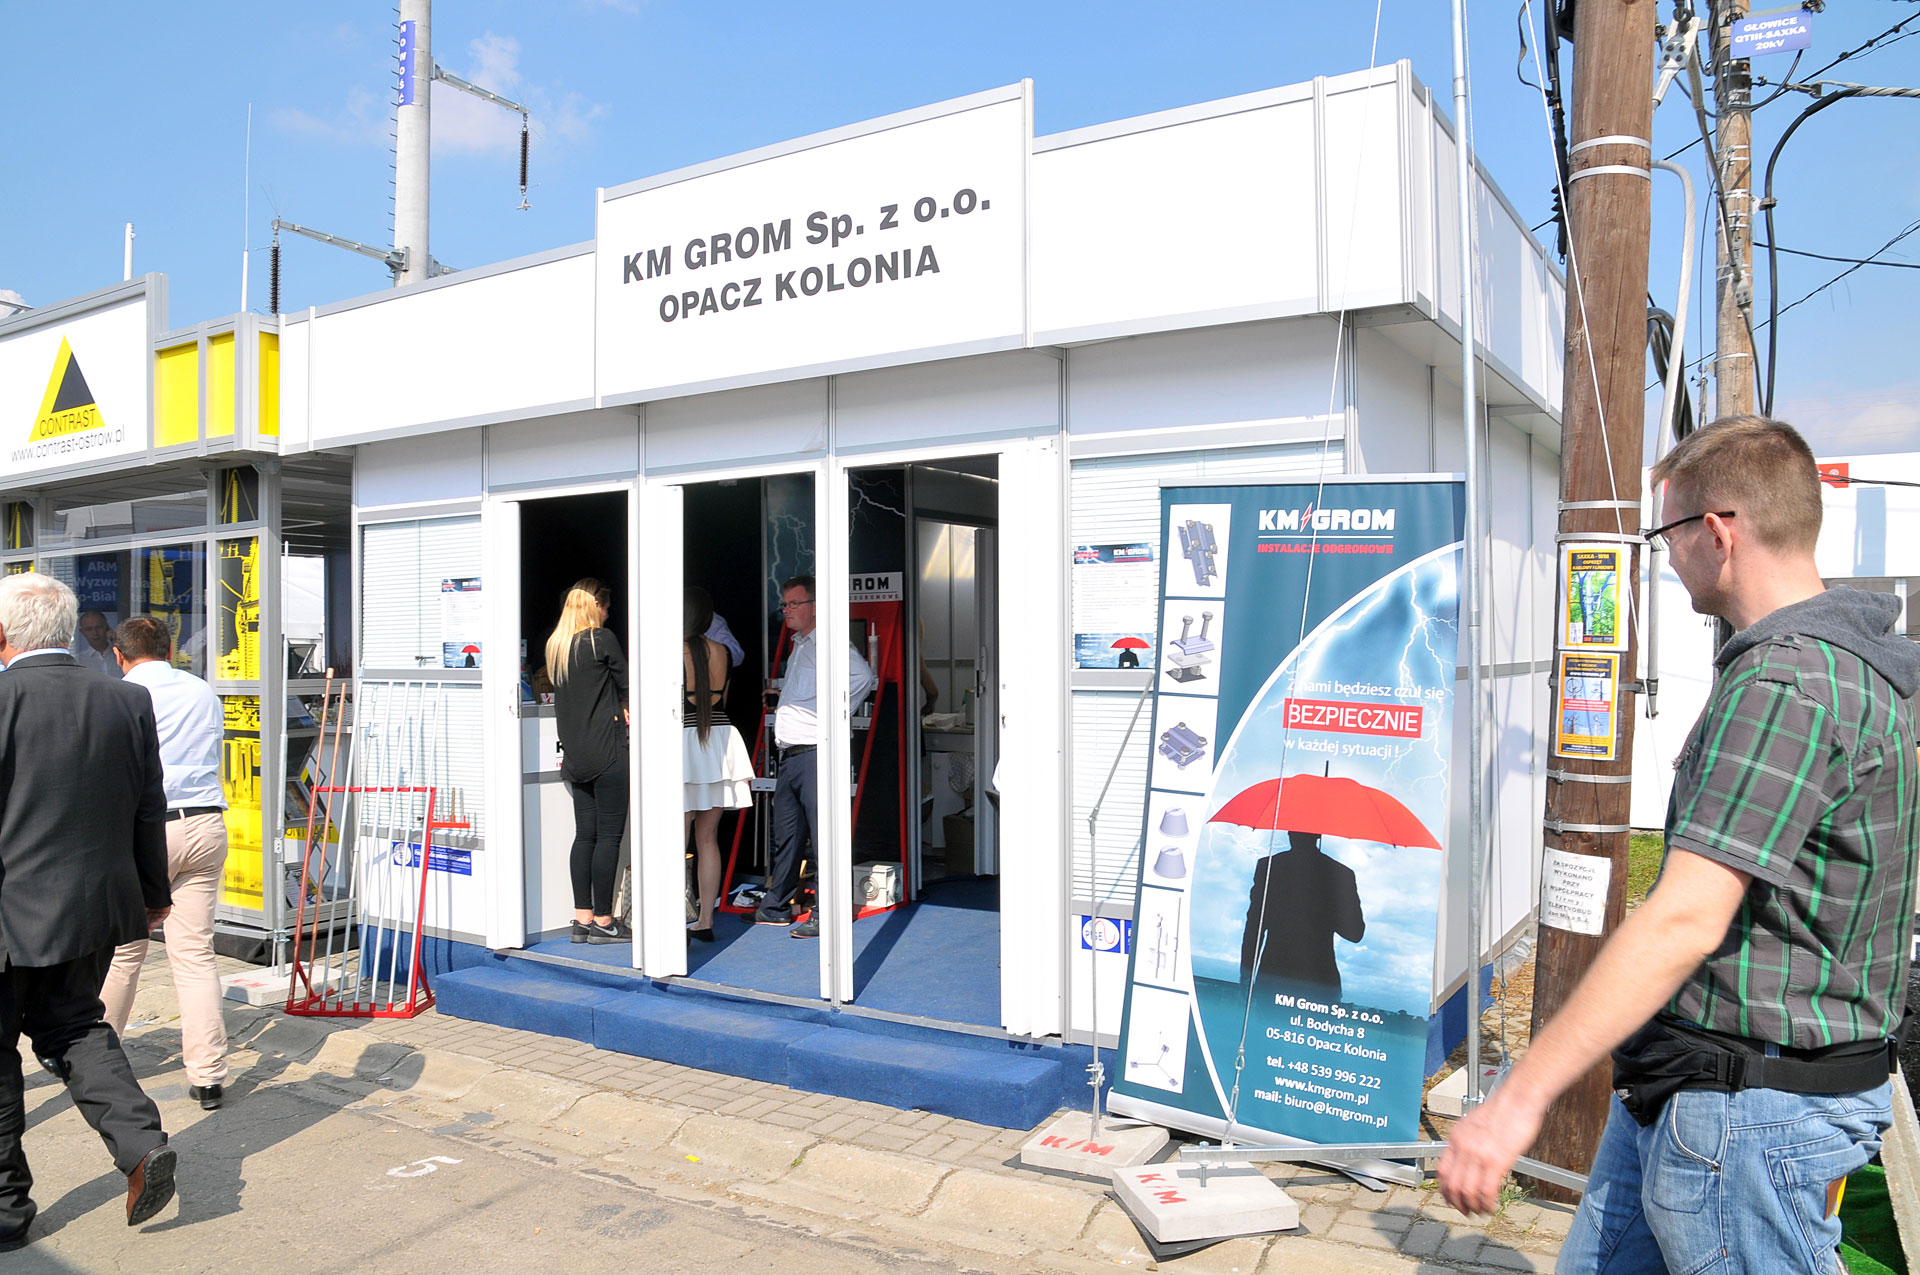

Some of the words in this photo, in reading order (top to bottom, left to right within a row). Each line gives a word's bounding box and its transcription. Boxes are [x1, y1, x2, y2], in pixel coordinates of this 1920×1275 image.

[1743, 16, 1798, 32] GŁOWICE
[1755, 39, 1785, 50] 20kV
[399, 23, 407, 104] NOWOŚĆ
[623, 245, 672, 285] KM
[684, 218, 792, 271] GROM
[805, 211, 865, 248] Sp.
[879, 203, 899, 231] z
[913, 188, 991, 223] o.o.
[659, 277, 763, 323] OPACZ
[775, 244, 941, 302] KOLONIA
[39, 408, 96, 437] CONTRAST
[10, 423, 126, 462] www.contrast-ostrow.pl
[1258, 509, 1300, 531] KM
[1311, 508, 1396, 531] GROM
[1257, 543, 1321, 554] INSTALACJE
[1322, 544, 1394, 554] ODGROMOWE
[852, 577, 889, 591] ROM
[1334, 680, 1392, 698] będziesz
[1394, 685, 1422, 699] czuł
[1424, 686, 1445, 702] się
[1288, 704, 1419, 732] BEZPIECZNIE
[1297, 737, 1340, 756] każdej
[1341, 743, 1393, 761] sytuacji
[1562, 879, 1581, 888] PRZY
[1274, 993, 1295, 1008] KM
[1296, 998, 1329, 1014] Grom
[1330, 1004, 1349, 1019] Sp.
[1351, 1010, 1359, 1020] z
[1360, 1012, 1384, 1025] o.o.
[1290, 1015, 1304, 1028] ul.
[1306, 1017, 1355, 1037] Bodycha
[1356, 1028, 1366, 1039] 8
[1266, 1027, 1305, 1045] 05-816
[1306, 1035, 1342, 1051] Opacz
[1343, 1042, 1387, 1062] Kolonia
[1266, 1055, 1285, 1069] tel.
[1287, 1061, 1309, 1074] +48
[1310, 1064, 1333, 1079] 539
[1334, 1069, 1357, 1084] 996
[1358, 1074, 1382, 1090] 222
[1274, 1076, 1370, 1106] www.kmgrom.pl
[1254, 1089, 1282, 1104] mail:
[1284, 1093, 1389, 1129] biuro@kmgrom.pl
